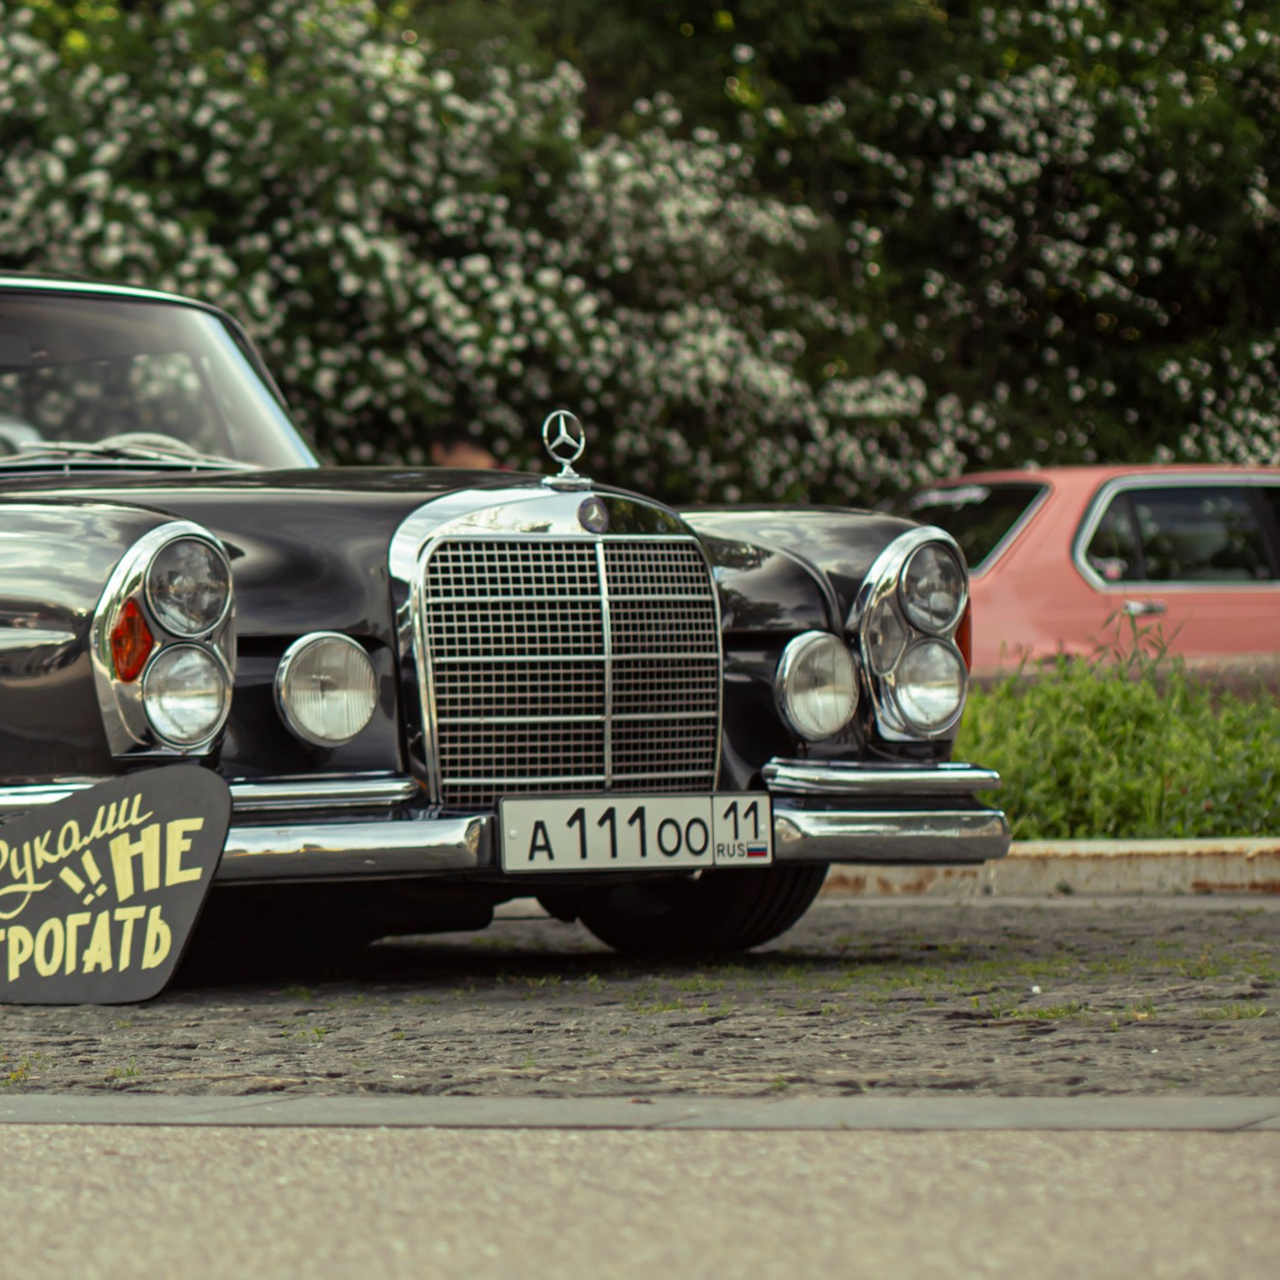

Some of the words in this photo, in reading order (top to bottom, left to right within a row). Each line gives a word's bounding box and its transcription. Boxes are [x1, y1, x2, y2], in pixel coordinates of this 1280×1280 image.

[723, 801, 759, 841] 11
[109, 817, 205, 903] НЕ
[717, 843, 746, 858] RUS
